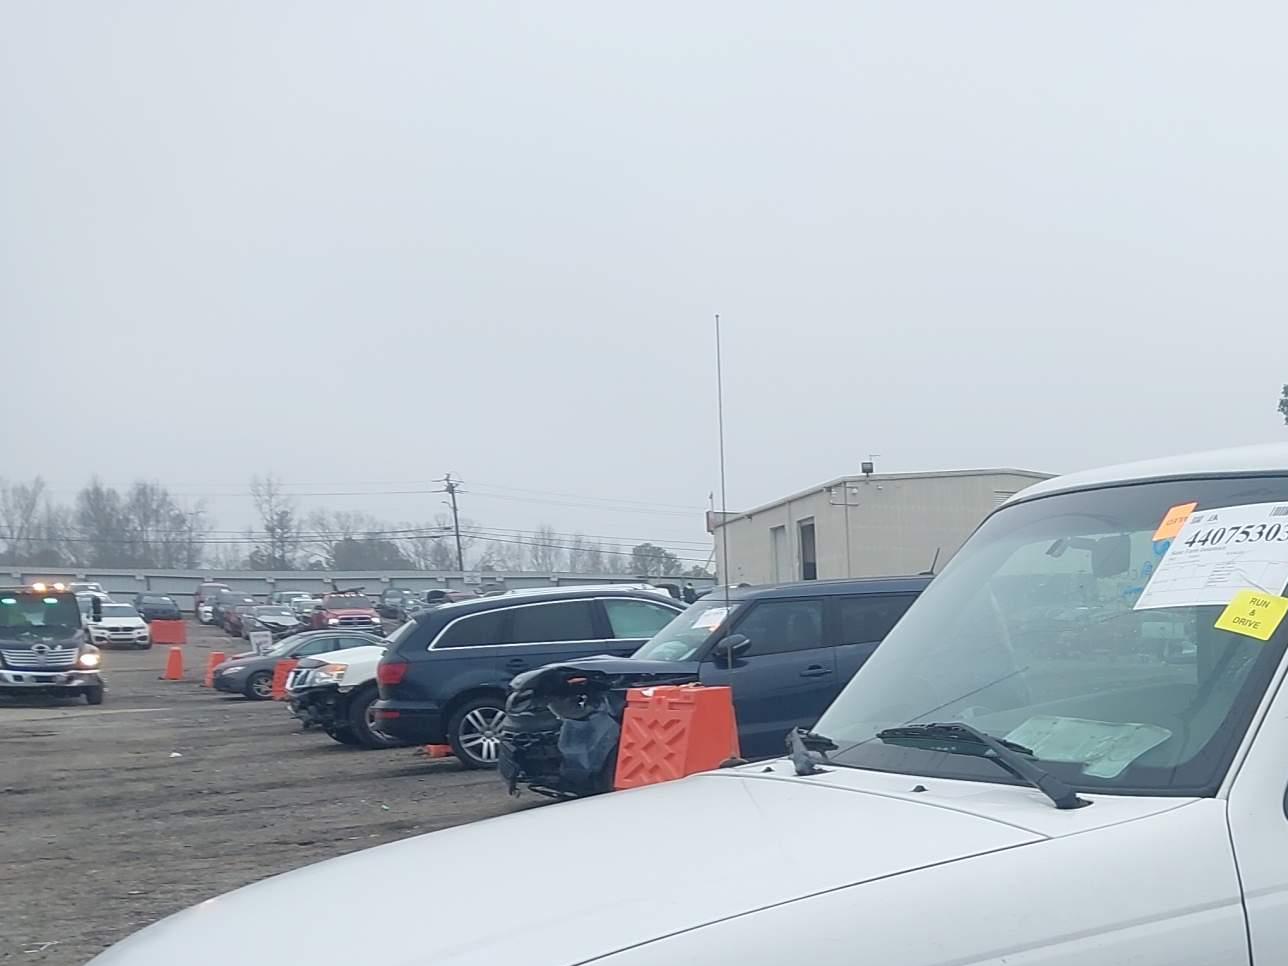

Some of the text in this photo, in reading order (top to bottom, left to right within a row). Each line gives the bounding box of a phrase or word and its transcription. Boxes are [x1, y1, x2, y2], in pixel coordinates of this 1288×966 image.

[1248, 597, 1271, 609] RUN
[1248, 609, 1257, 617] &
[1232, 616, 1262, 630] DRIVE
